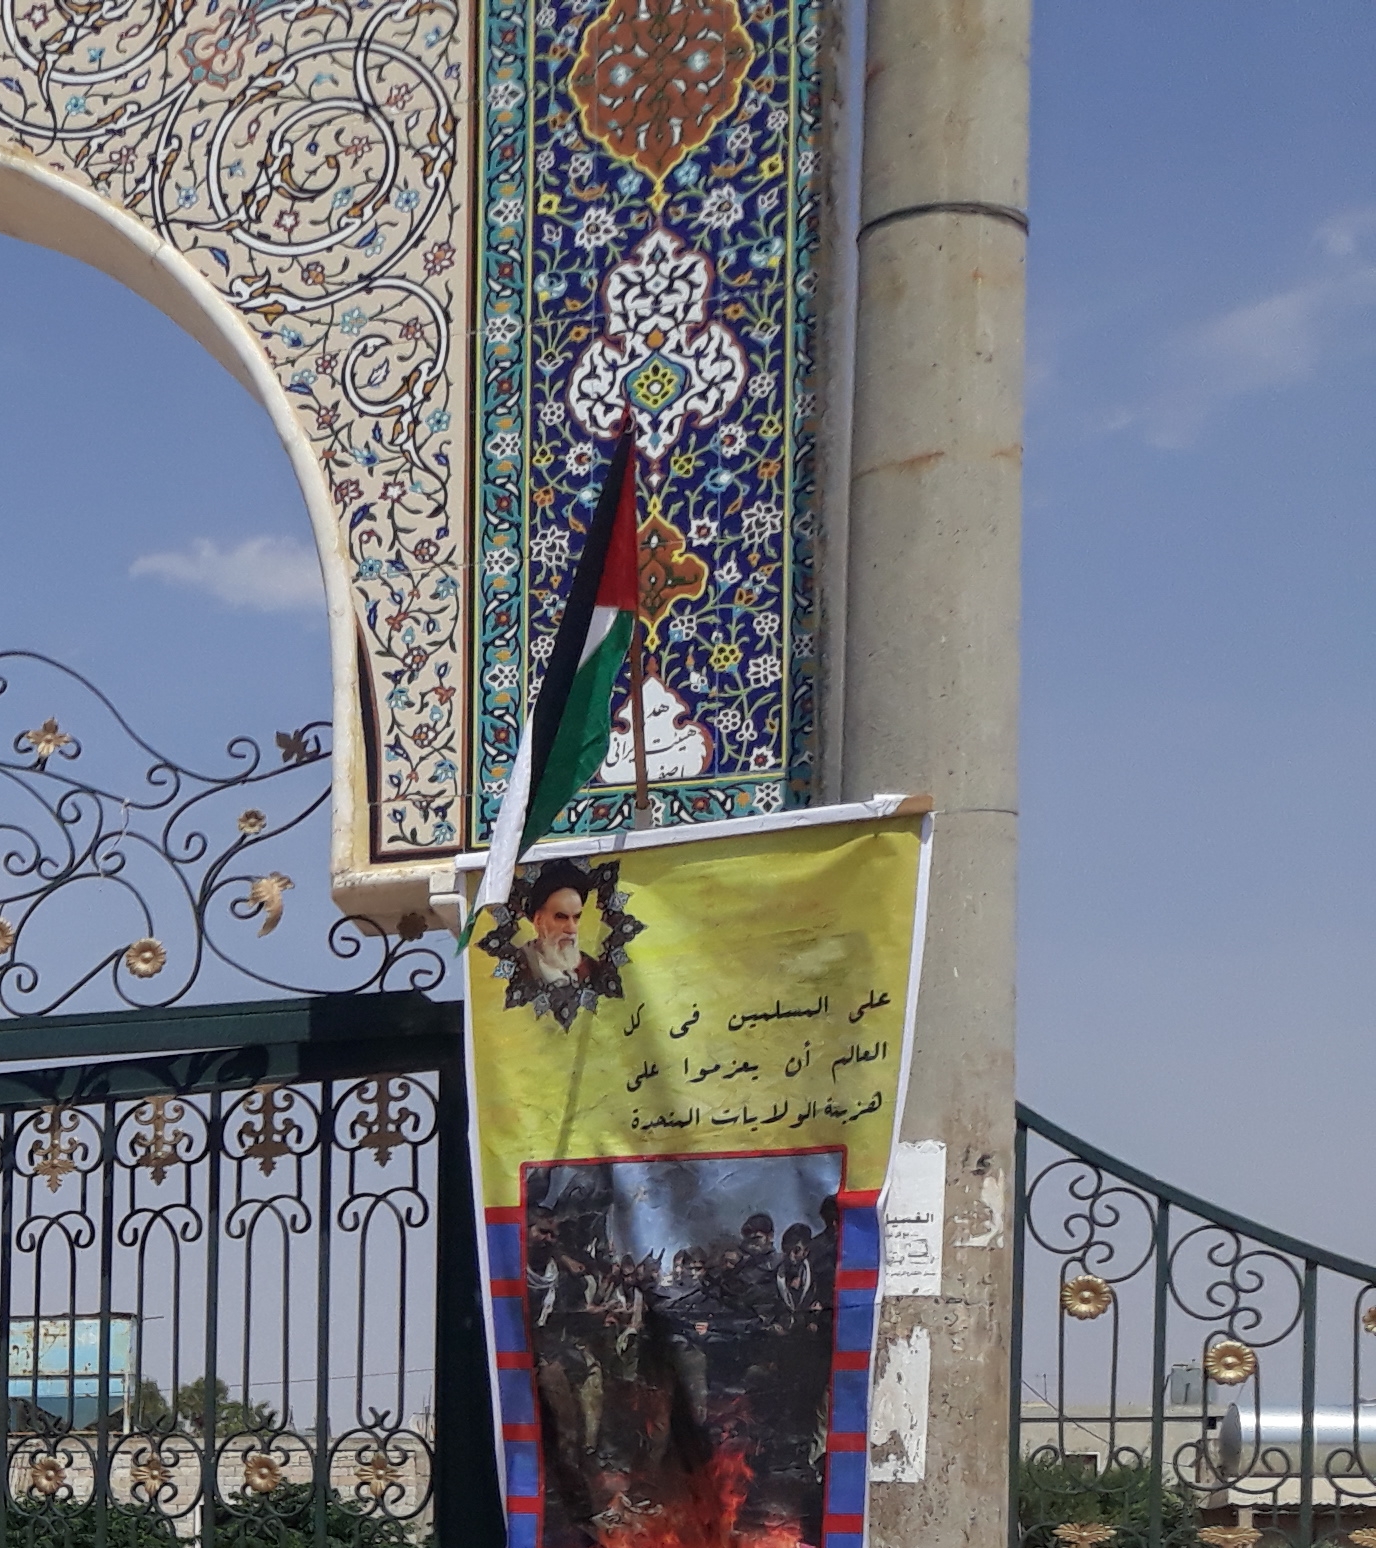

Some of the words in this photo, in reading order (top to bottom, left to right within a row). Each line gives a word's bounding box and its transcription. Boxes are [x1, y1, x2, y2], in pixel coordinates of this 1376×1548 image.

[624, 1002, 644, 1036] كل
[729, 996, 828, 1031] المسلمين
[684, 1057, 759, 1082] يعزموا
[785, 1041, 810, 1077] أن
[832, 1041, 888, 1084] العالم
[631, 1106, 700, 1131] المتحدة
[711, 1099, 816, 1132] الولايات
